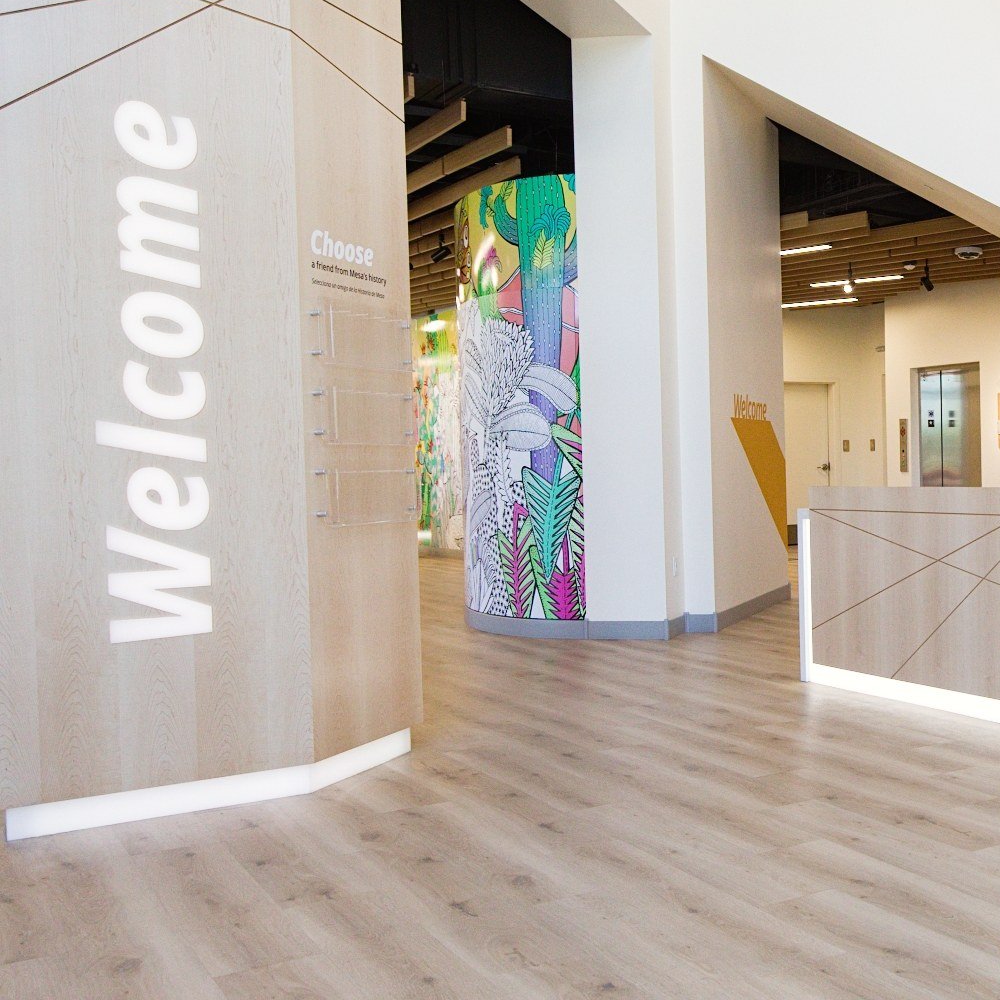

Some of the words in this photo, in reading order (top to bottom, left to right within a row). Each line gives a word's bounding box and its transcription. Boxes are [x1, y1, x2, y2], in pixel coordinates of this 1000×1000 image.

[310, 229, 374, 267] Choose
[311, 261, 315, 269] a
[316, 260, 334, 273] friend
[334, 265, 349, 277] from
[349, 269, 368, 281] Mesa's
[368, 273, 387, 287] history
[95, 100, 213, 644] Welcome
[733, 393, 767, 420] Welcome
